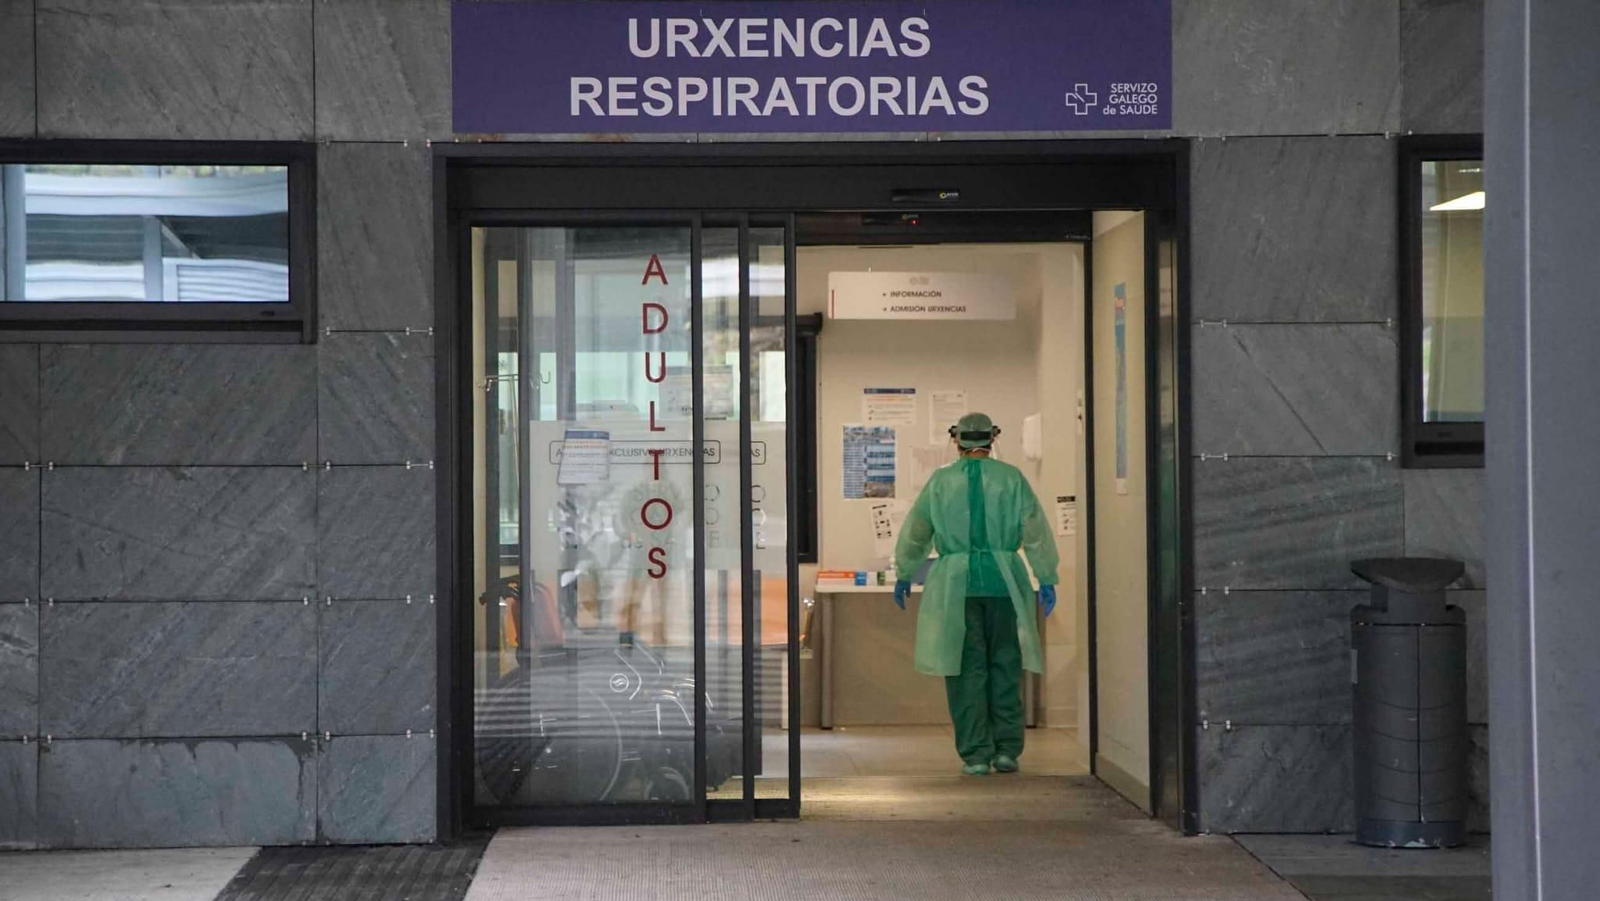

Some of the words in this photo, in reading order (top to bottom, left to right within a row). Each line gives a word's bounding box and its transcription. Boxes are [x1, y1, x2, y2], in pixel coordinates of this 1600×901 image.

[628, 17, 931, 58] URXENCIAS
[1110, 83, 1158, 93] SERVIZO
[570, 75, 989, 117] RESPIRATORIAS
[1109, 94, 1158, 104] GALEGO
[1103, 105, 1117, 115] de
[890, 290, 942, 298] INFORMACIÓN
[927, 305, 967, 313] URXENCIAS
[641, 254, 673, 578] ADULTOS
